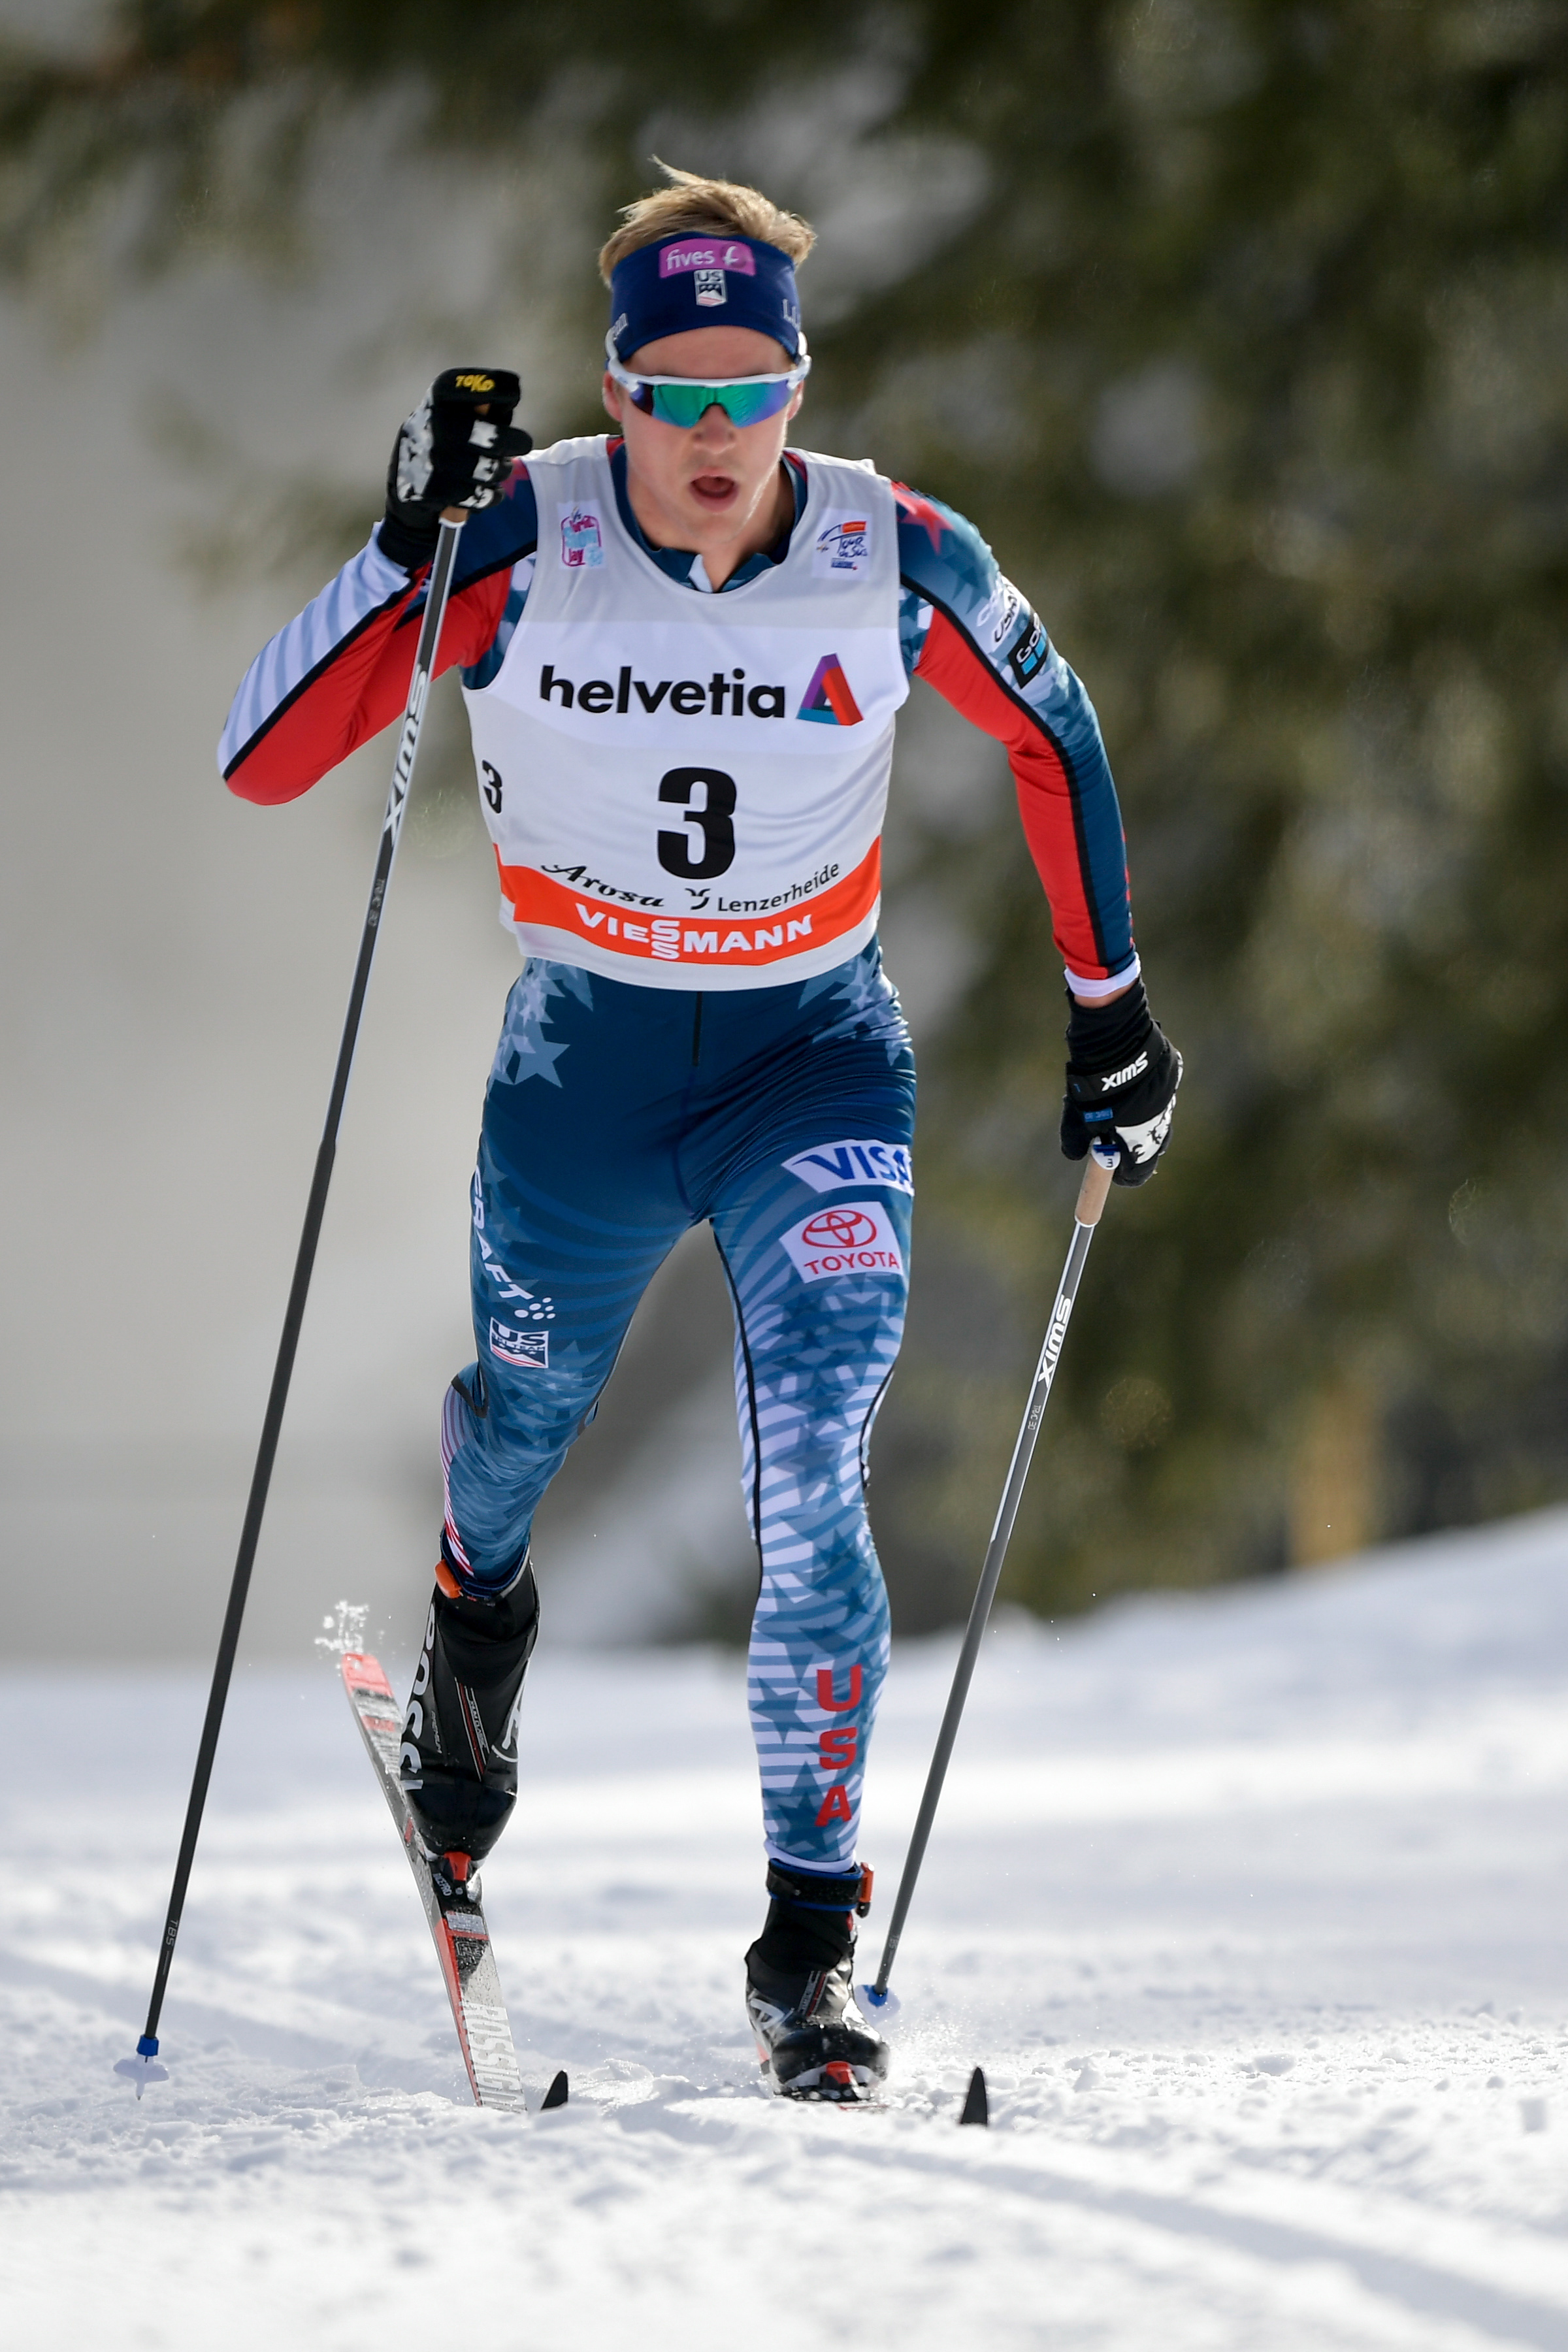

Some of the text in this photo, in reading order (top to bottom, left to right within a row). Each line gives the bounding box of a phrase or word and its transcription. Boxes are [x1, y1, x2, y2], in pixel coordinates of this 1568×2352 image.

[666, 248, 714, 270] fives
[540, 664, 785, 719] helvetia
[482, 759, 503, 815] 3
[657, 766, 738, 880] 3
[540, 862, 840, 912] Arosa Lenzerheide
[576, 902, 813, 960] VIESSMANN
[1102, 1051, 1149, 1092] SWIX
[791, 1145, 911, 1185] VISA
[473, 1164, 535, 1300] CRAFT
[804, 1250, 900, 1275] TOYOTA
[491, 1319, 546, 1347] US
[1037, 1294, 1072, 1389] SWIX
[814, 1663, 862, 1827] USA
